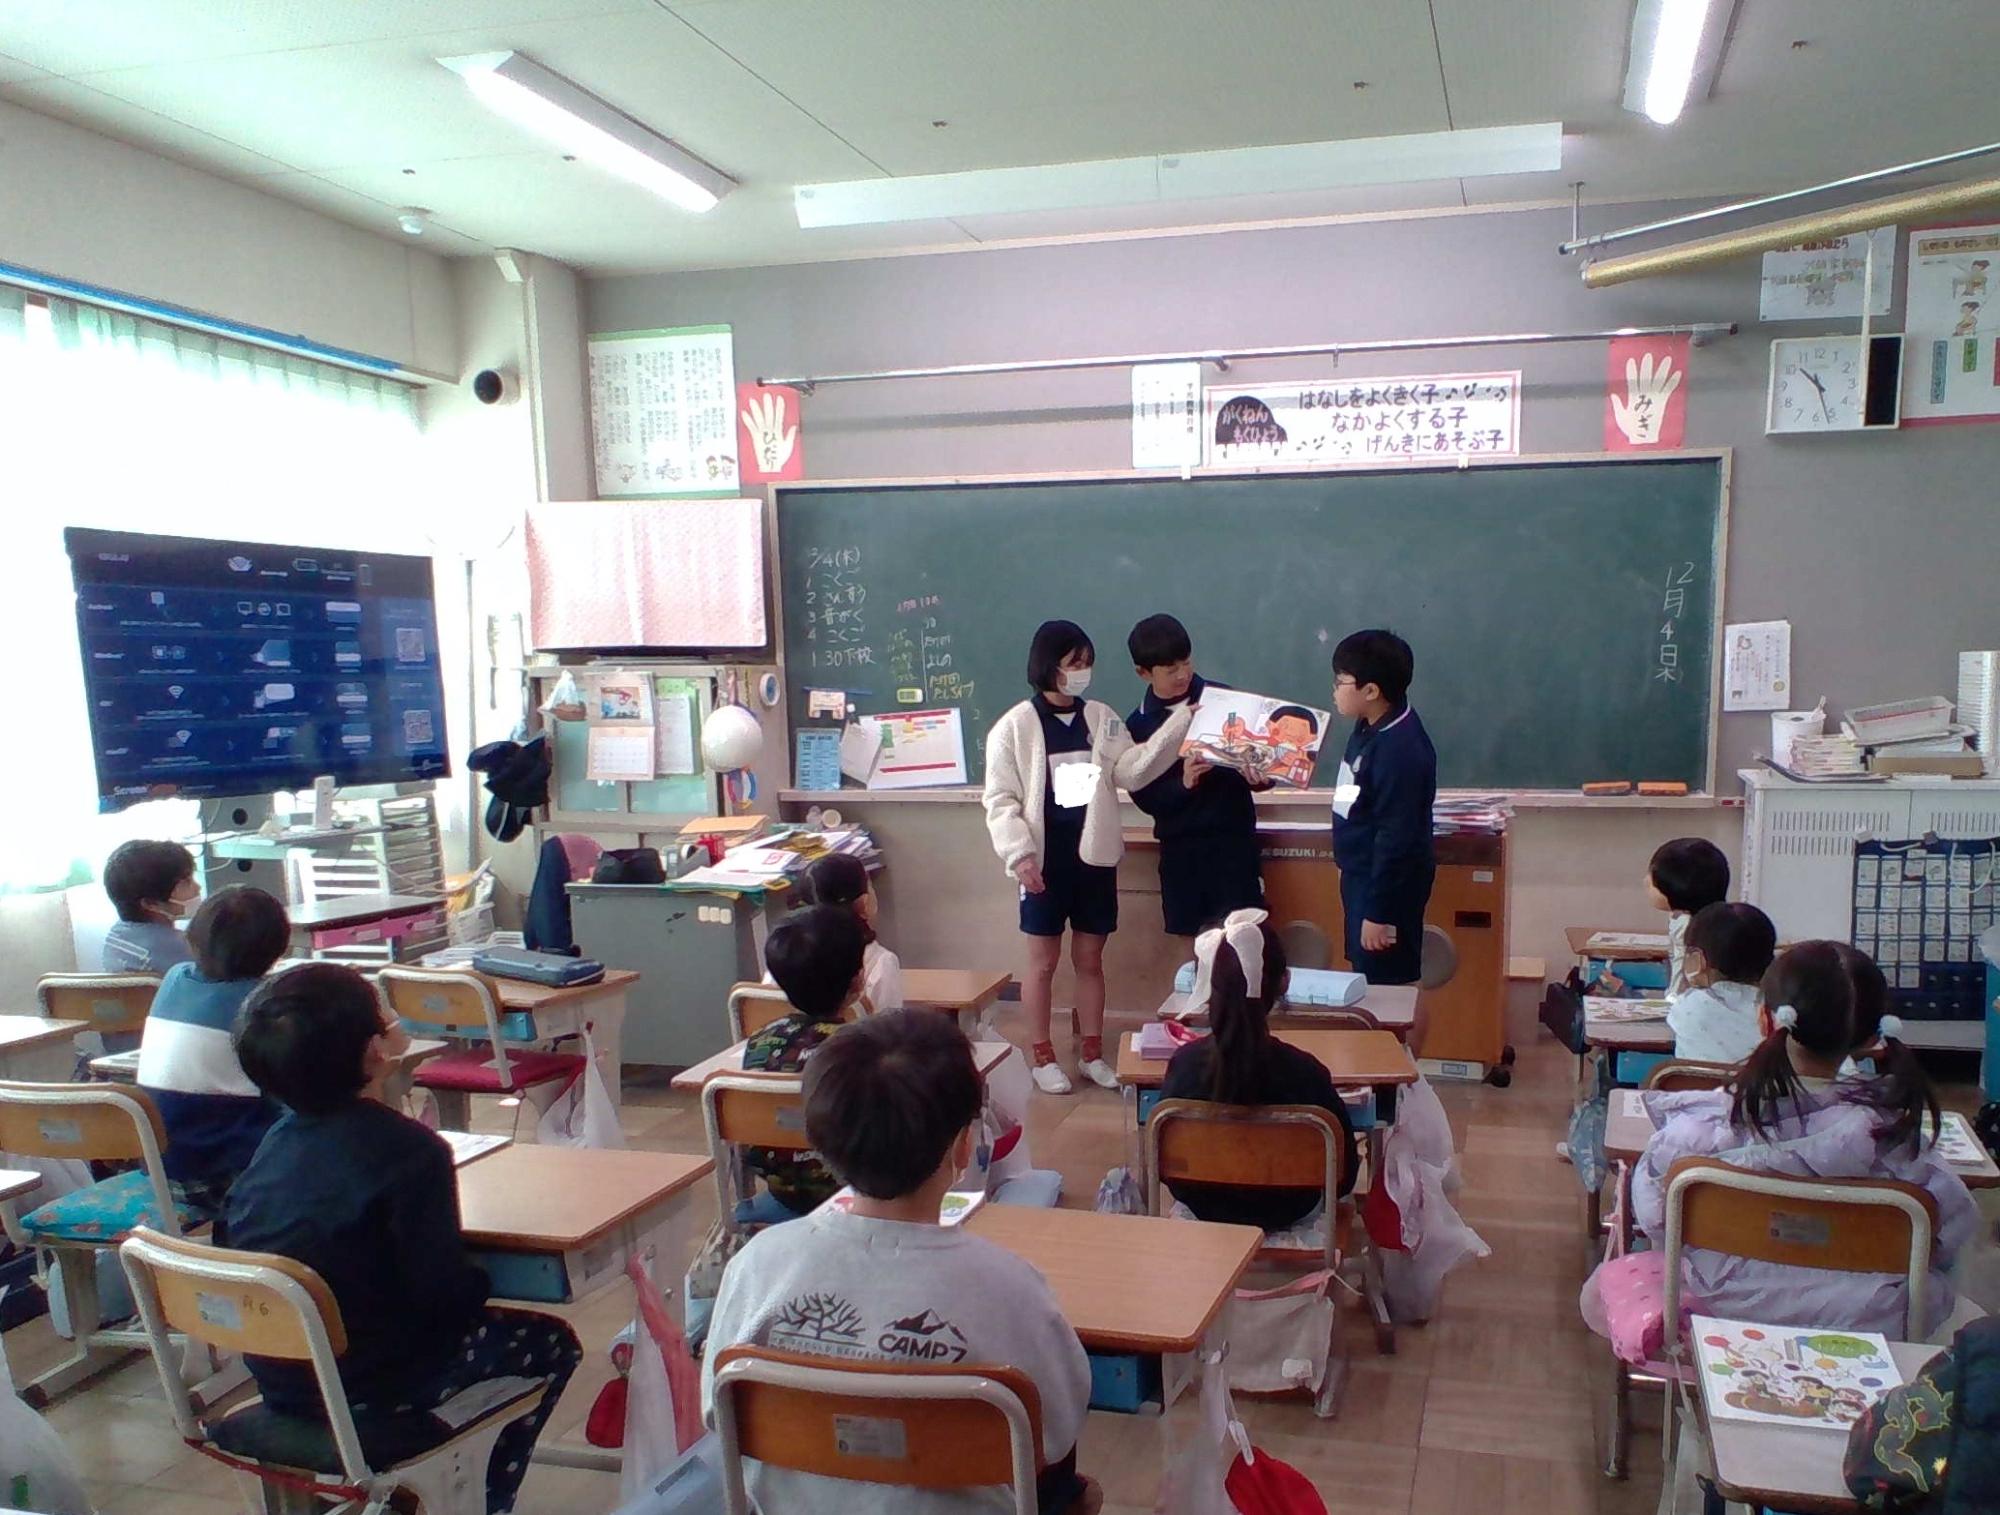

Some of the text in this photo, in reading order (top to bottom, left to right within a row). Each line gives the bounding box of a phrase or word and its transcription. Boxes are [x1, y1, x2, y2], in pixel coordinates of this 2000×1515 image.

[1815, 348, 1825, 359] 12
[1842, 361, 1851, 374] 2
[1299, 384, 1440, 410] はなしをよくきく子
[1222, 403, 1268, 424] がくねん
[1332, 406, 1468, 433] なかよくする子
[1634, 395, 1652, 438] みぎ
[1233, 425, 1278, 443] もくひょう
[1366, 429, 1505, 453] げんきにあそぶ子
[763, 431, 777, 470] ひだり
[821, 567, 861, 589] こくご
[806, 592, 816, 604] 2
[827, 625, 865, 643] こくご
[1273, 848, 1316, 858] SUZUKI
